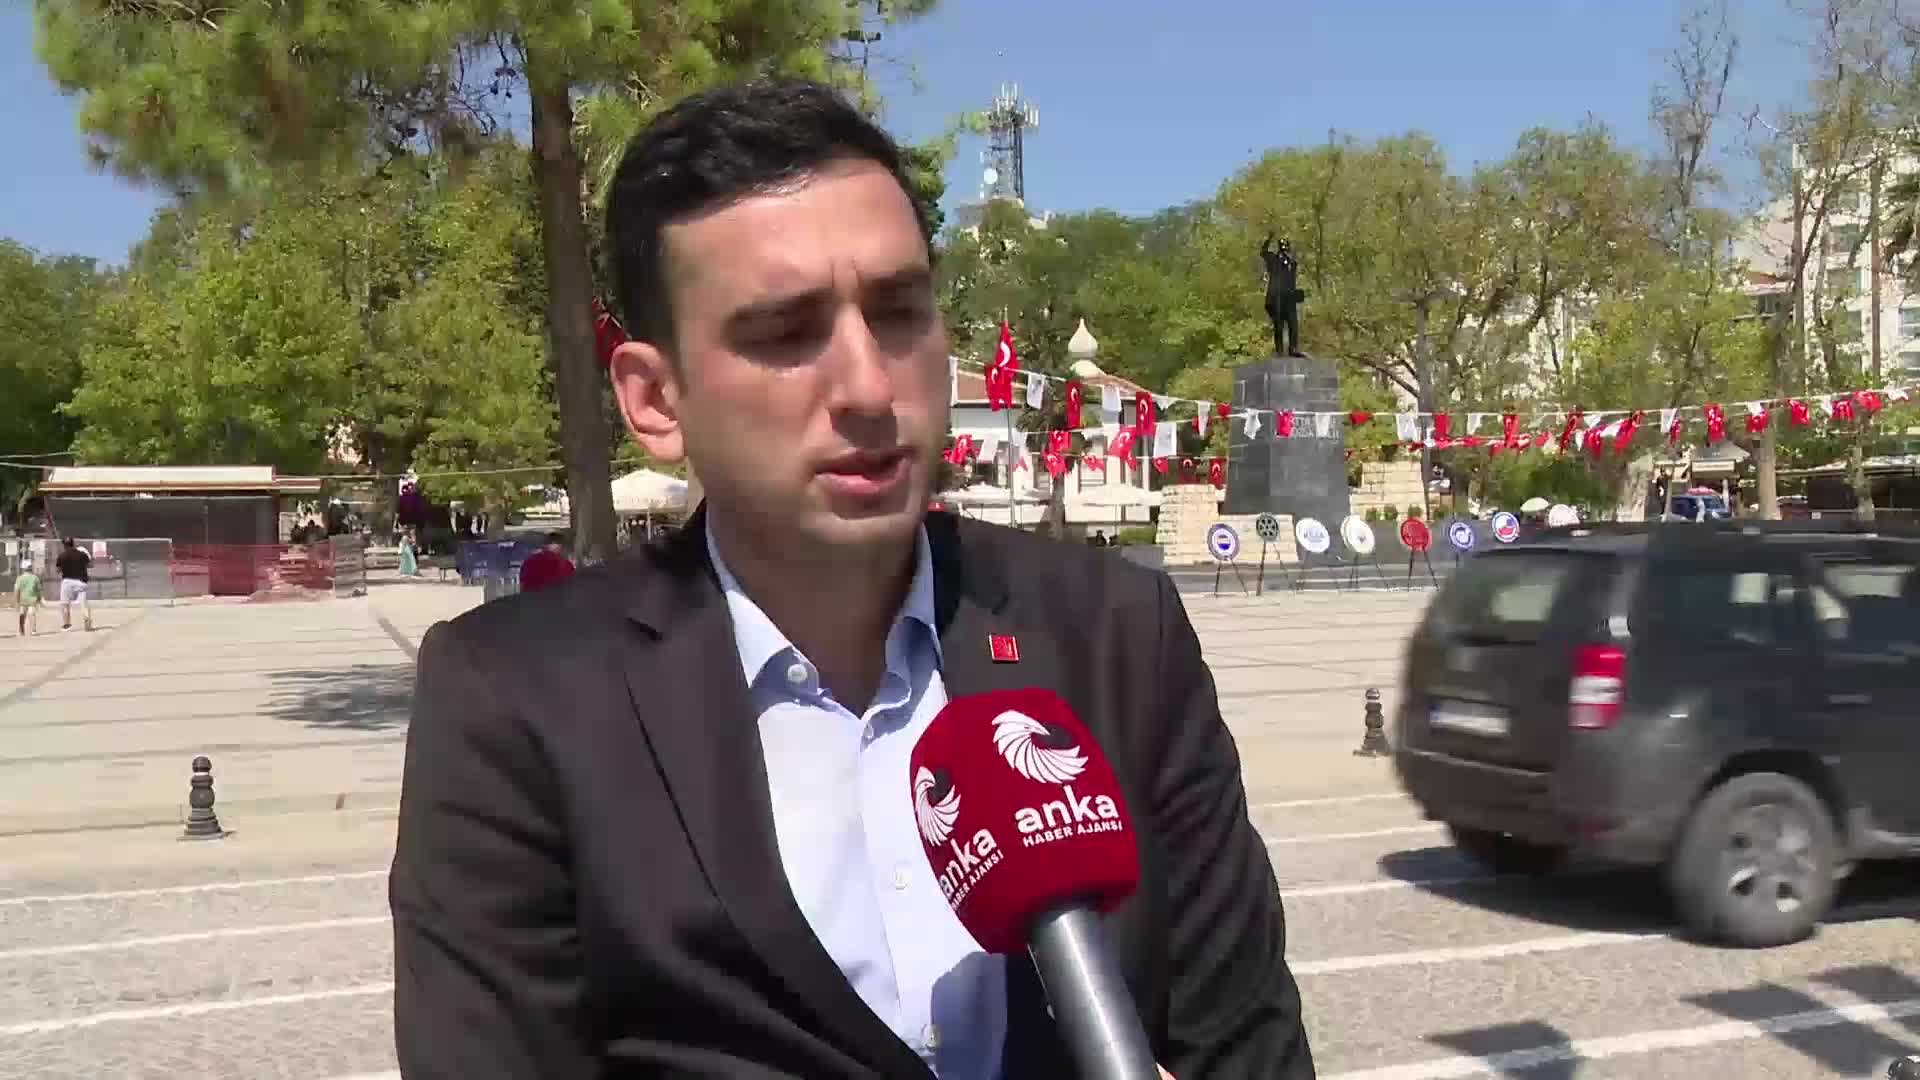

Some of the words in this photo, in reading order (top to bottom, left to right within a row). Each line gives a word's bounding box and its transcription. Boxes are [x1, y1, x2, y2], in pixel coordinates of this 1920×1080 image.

[1015, 784, 1120, 833] anka
[1022, 826, 1073, 848] HABER
[1077, 820, 1123, 835] AJANSI
[940, 828, 997, 899] anka
[969, 849, 1004, 886] AJANSI
